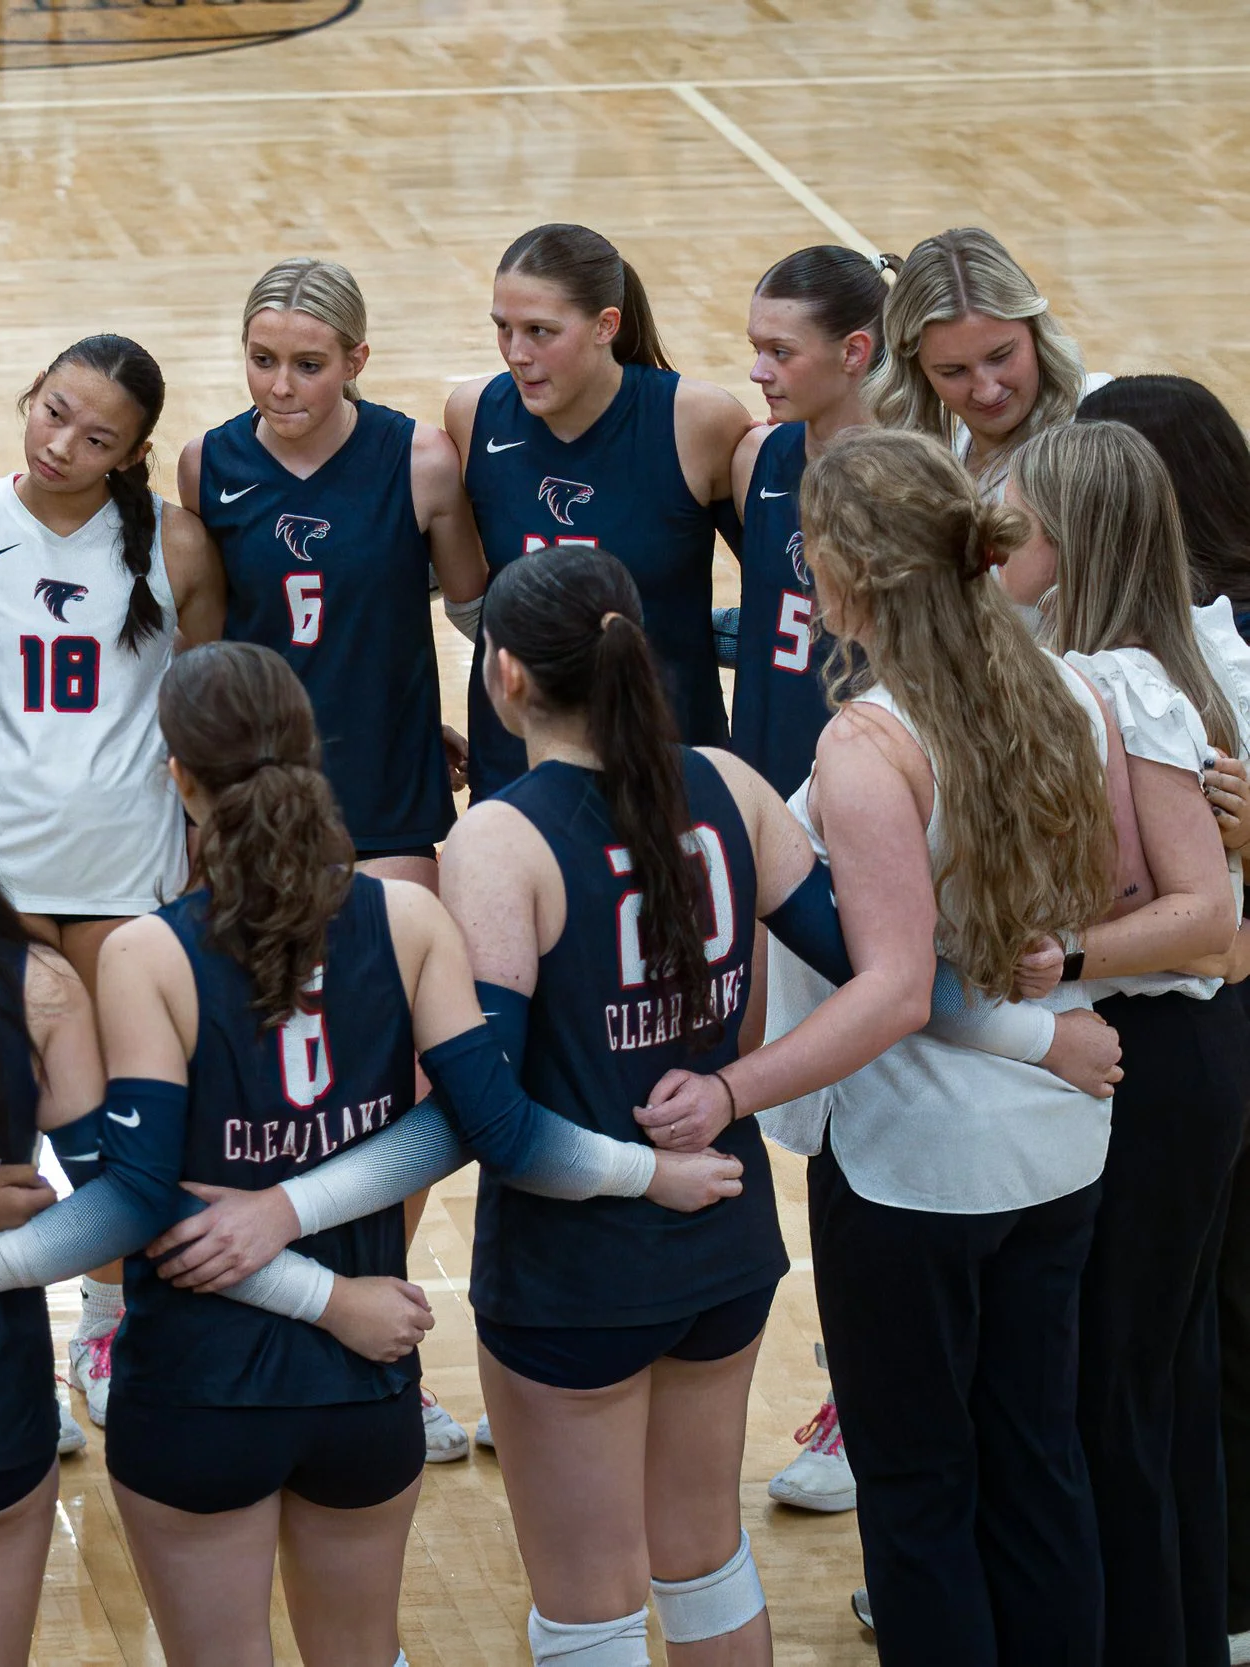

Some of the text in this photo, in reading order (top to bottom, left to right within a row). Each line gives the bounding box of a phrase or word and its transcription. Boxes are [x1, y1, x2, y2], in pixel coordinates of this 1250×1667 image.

[282, 571, 323, 647] 6
[772, 588, 814, 675] 5
[20, 634, 101, 713] 18
[316, 1095, 393, 1157] LAKE
